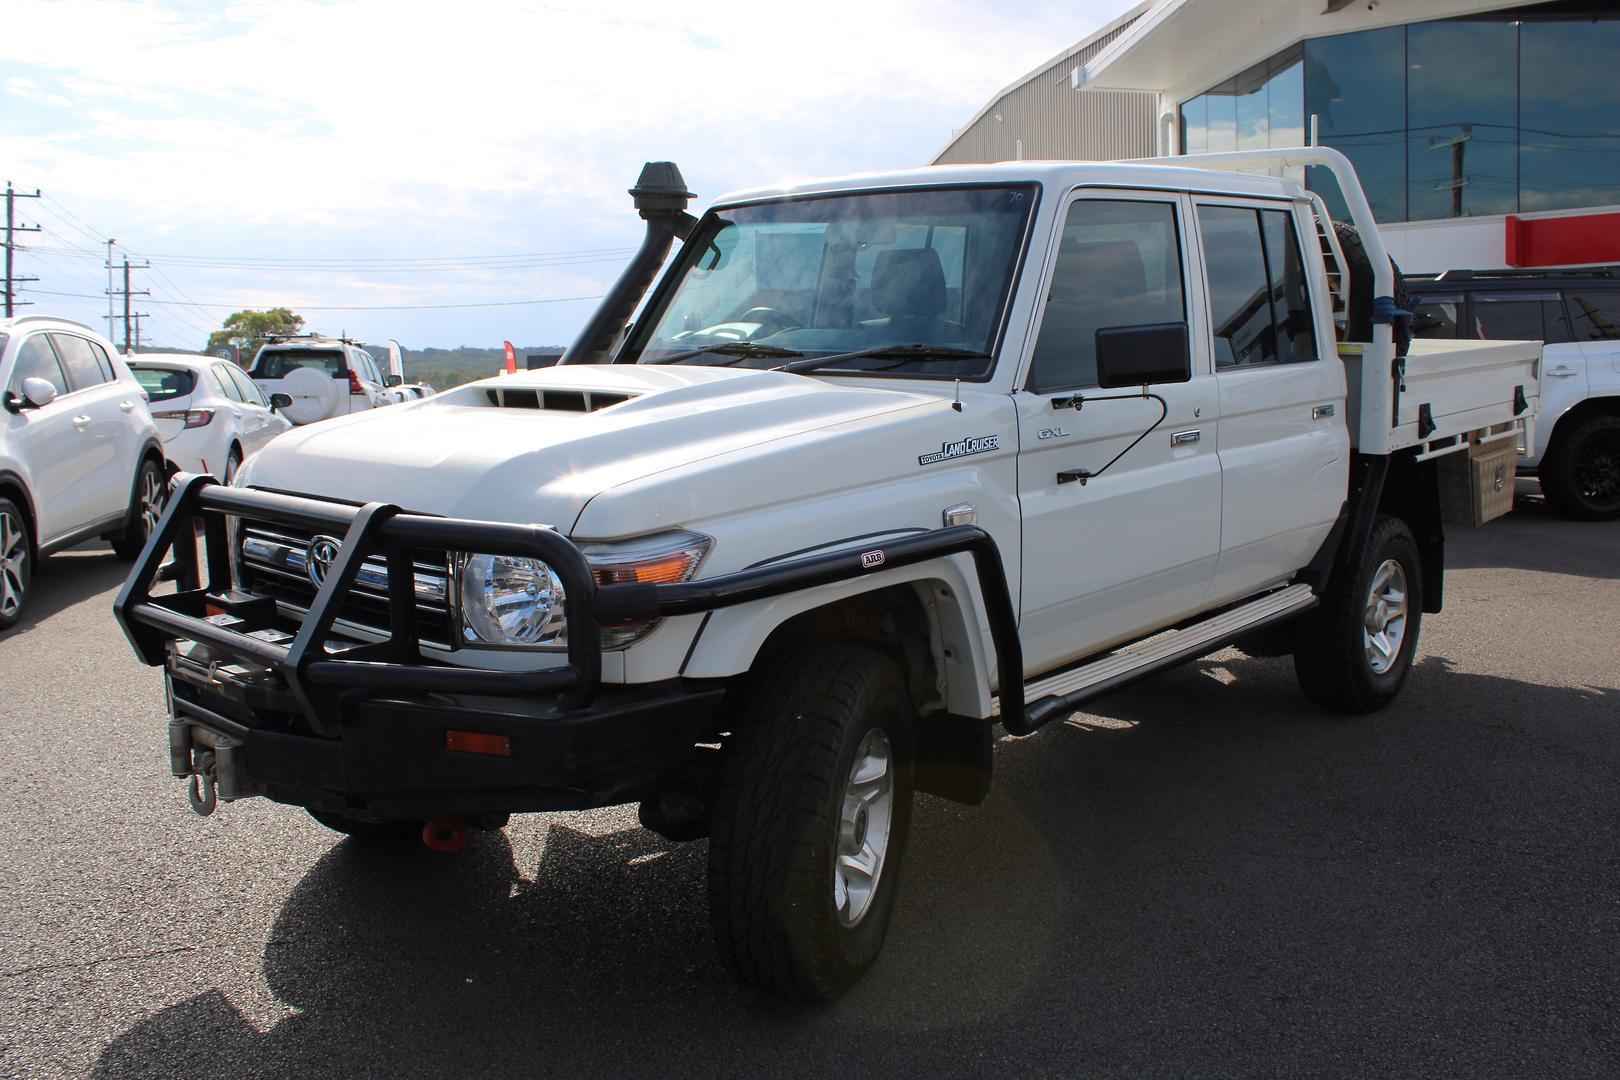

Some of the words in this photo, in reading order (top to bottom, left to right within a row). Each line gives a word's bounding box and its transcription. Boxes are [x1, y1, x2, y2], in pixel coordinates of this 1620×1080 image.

[1038, 427, 1070, 439] GXL
[920, 453, 944, 465] TOYOTA
[863, 552, 883, 565] ARB
